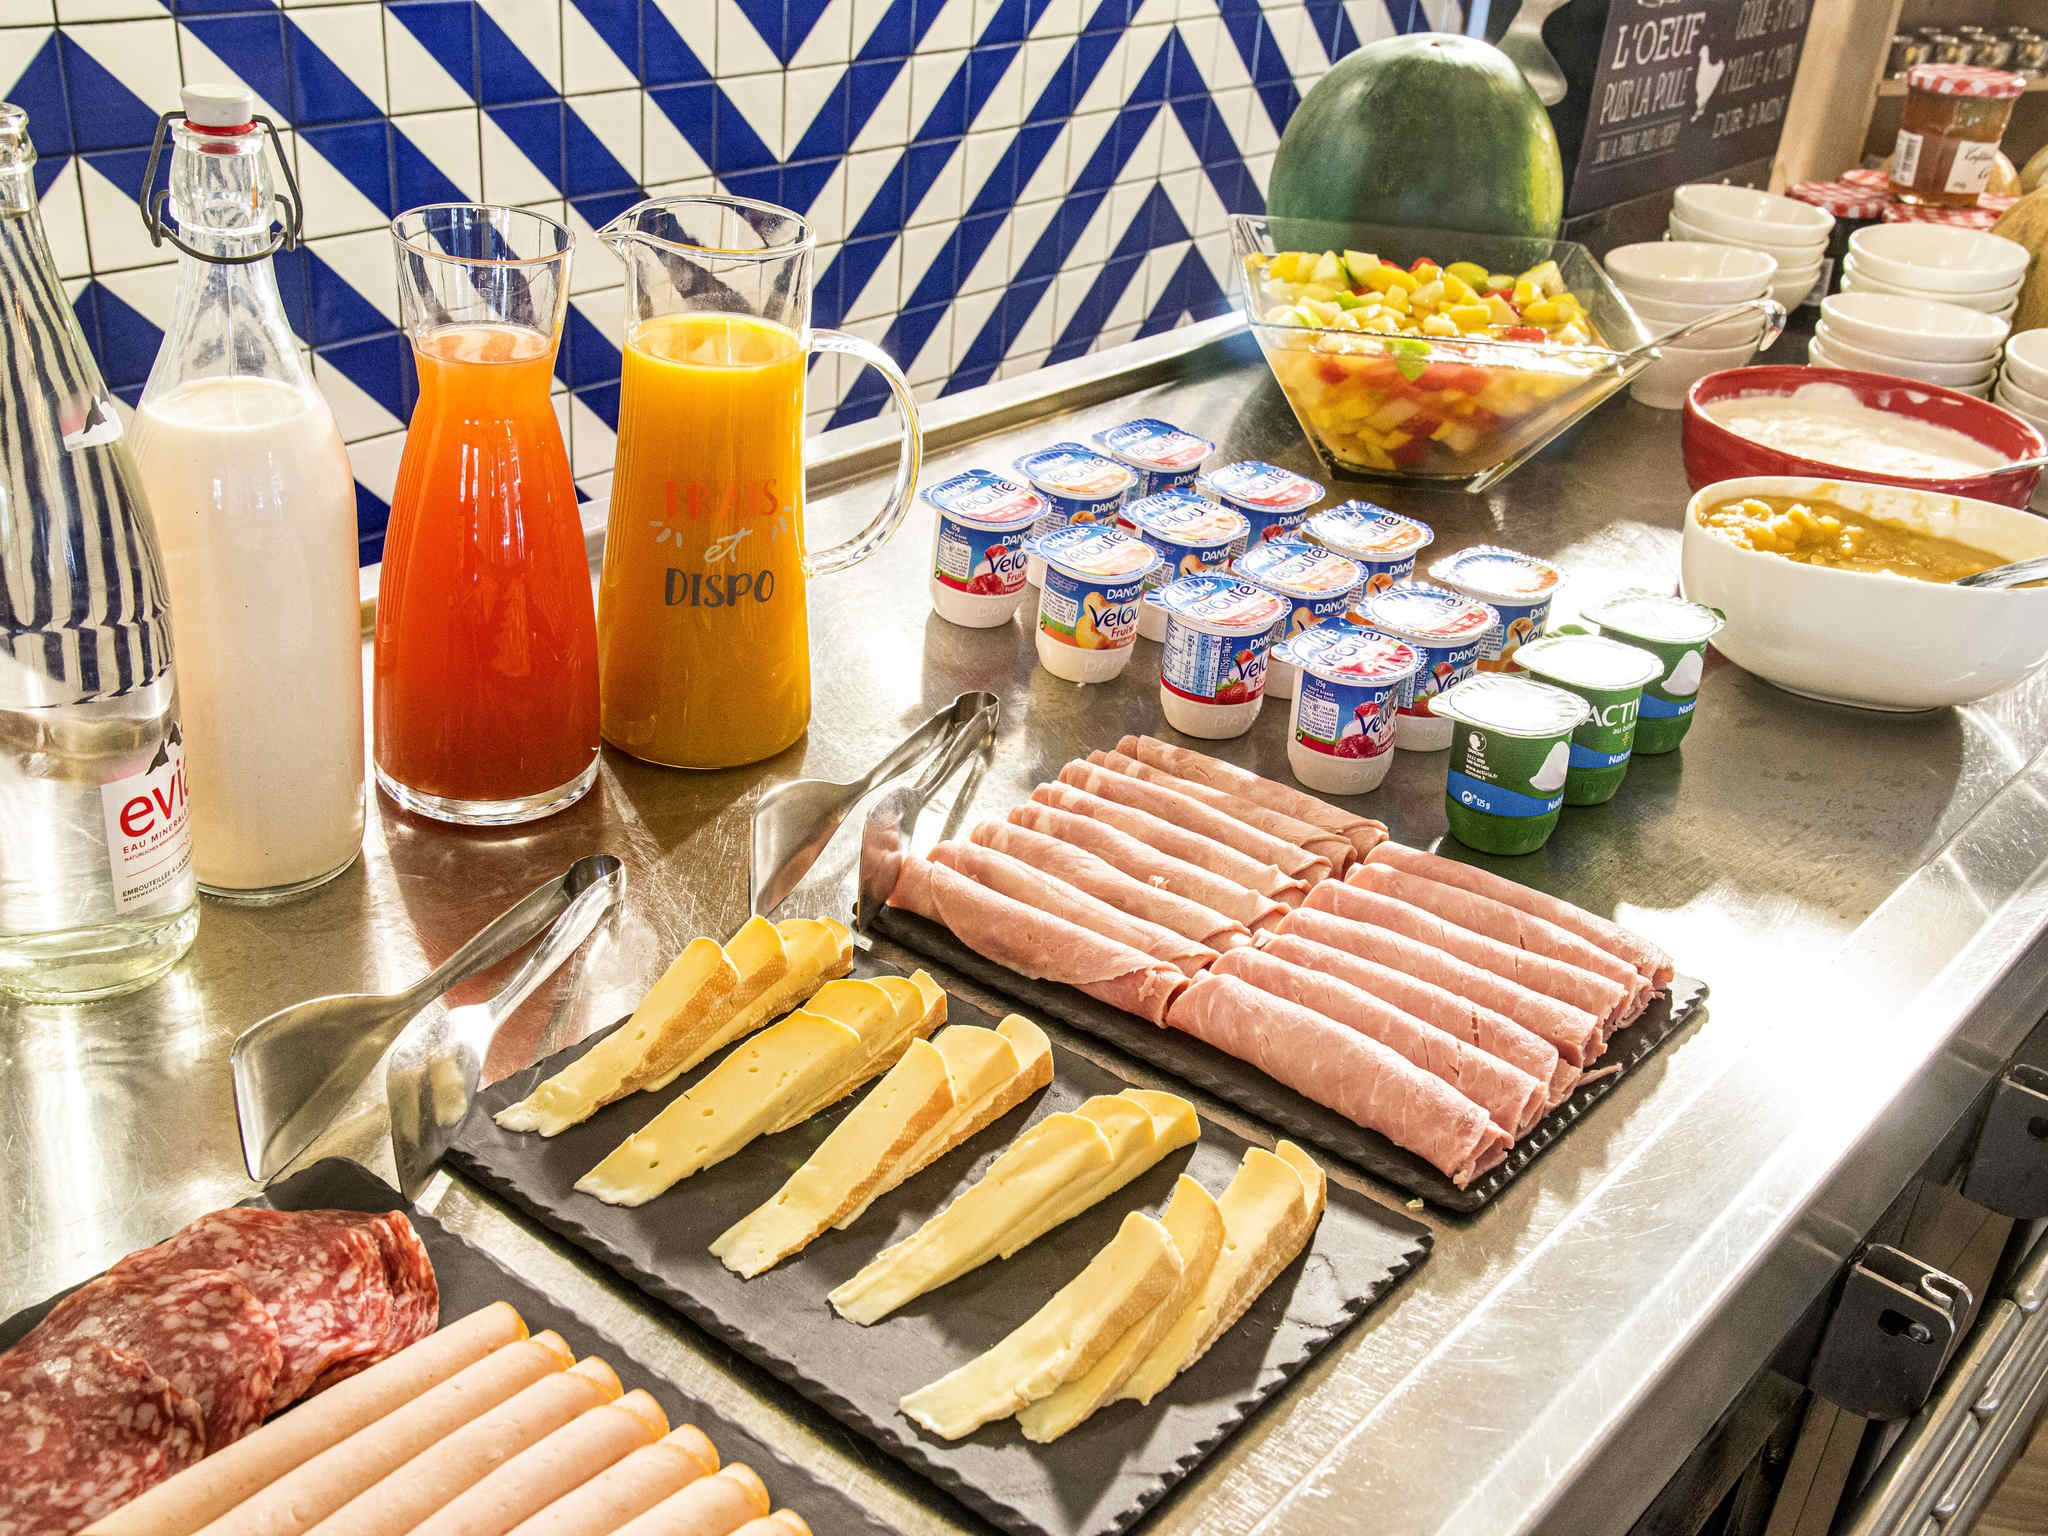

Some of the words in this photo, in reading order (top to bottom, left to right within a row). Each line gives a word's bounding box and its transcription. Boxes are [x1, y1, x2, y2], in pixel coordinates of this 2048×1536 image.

[1611, 11, 1706, 70] L'OEUF
[1600, 80, 1634, 125] PUIS
[1631, 77, 1651, 118] LA
[1651, 66, 1693, 112] POULE
[664, 479, 779, 521] FRAIS
[703, 528, 753, 563] et
[664, 567, 775, 608] DISPO
[123, 840, 146, 854] EAU
